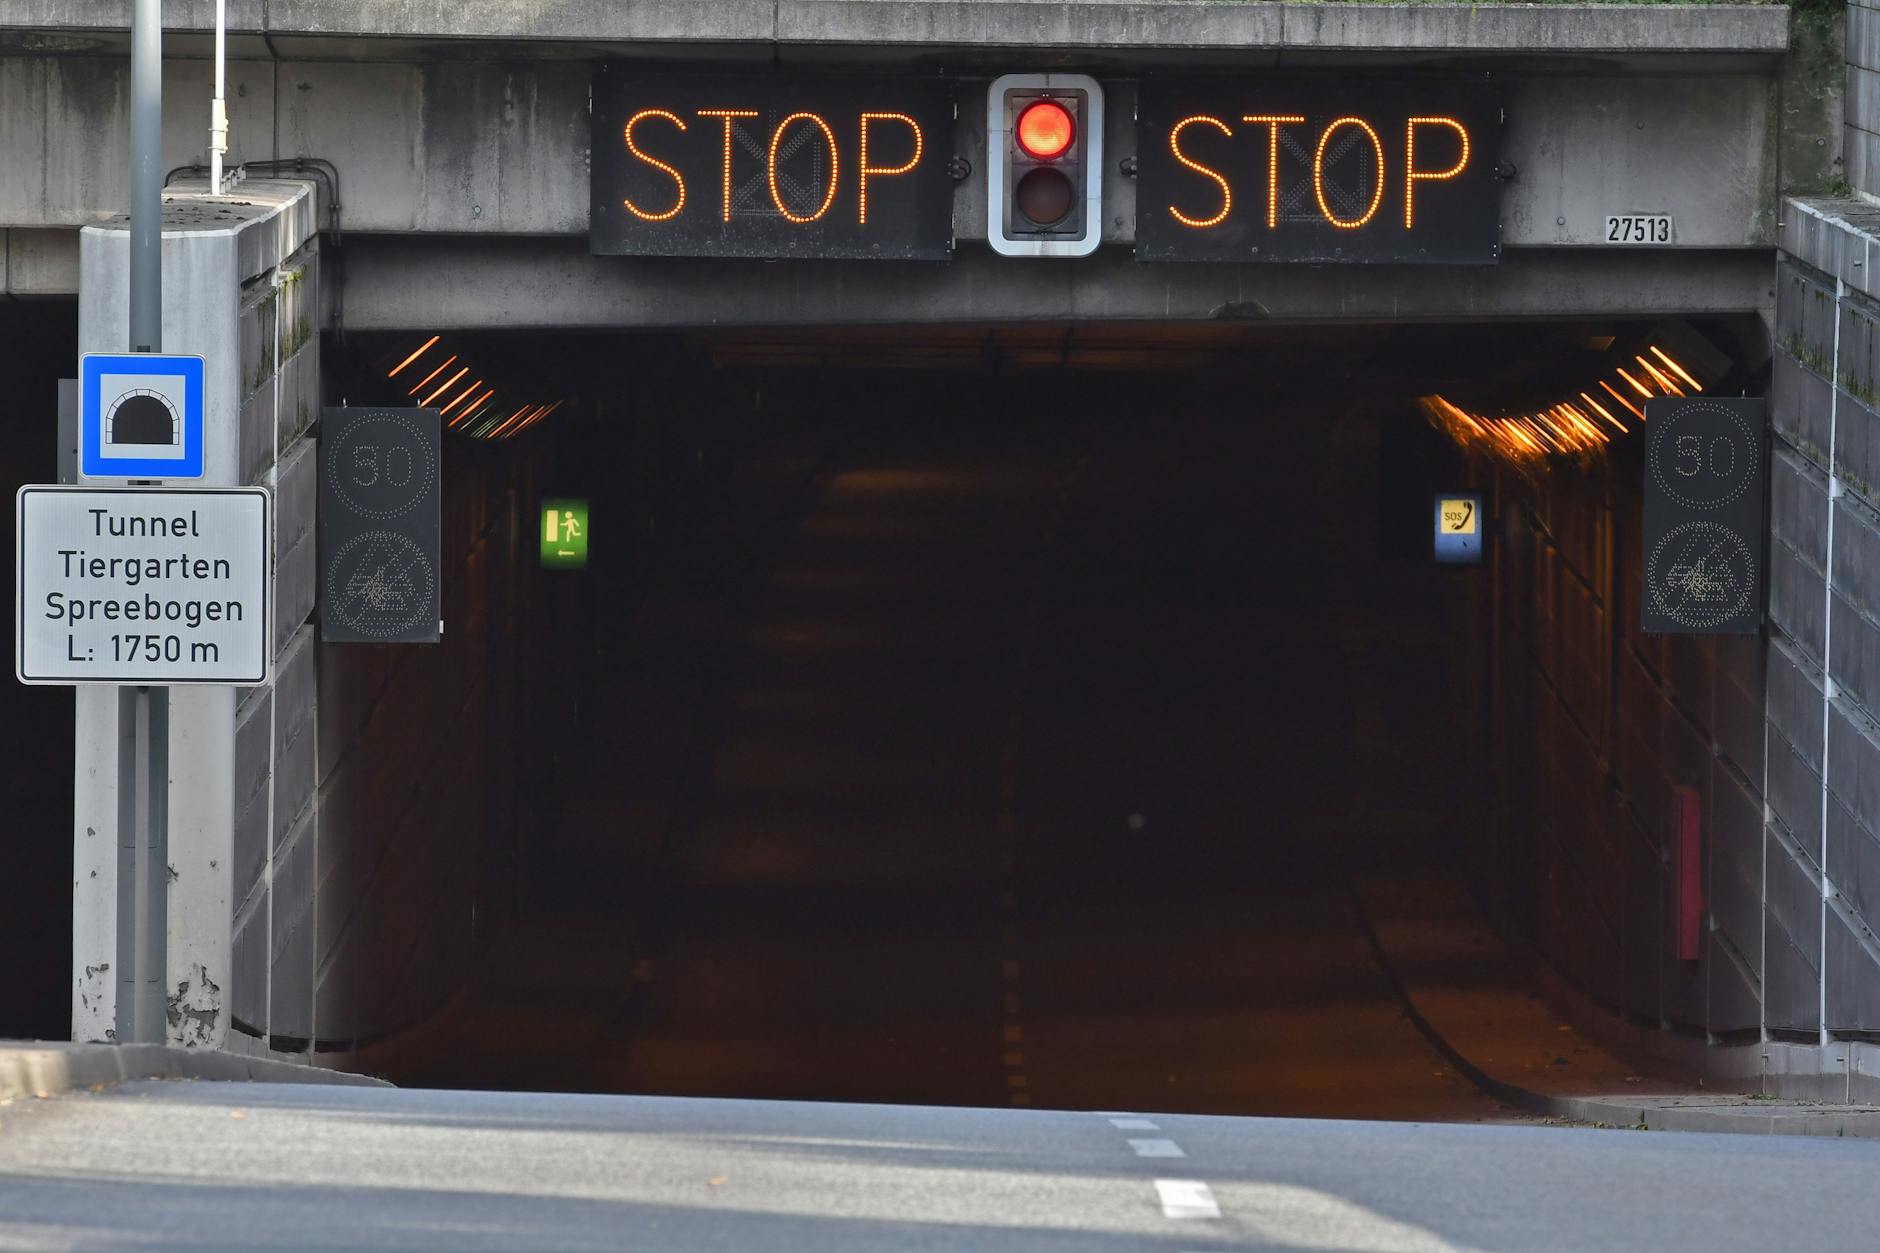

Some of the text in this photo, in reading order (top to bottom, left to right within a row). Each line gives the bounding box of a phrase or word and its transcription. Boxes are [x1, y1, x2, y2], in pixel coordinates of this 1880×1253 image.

[623, 109, 924, 224] STOP
[1168, 114, 1470, 230] STOP
[1608, 217, 1669, 242] 27513
[88, 509, 200, 537] Tunnel
[1444, 512, 1462, 521] SOS
[57, 550, 230, 585] Tiergarten
[45, 592, 243, 628] Spreebogen
[68, 634, 219, 662] L: 1750 m
